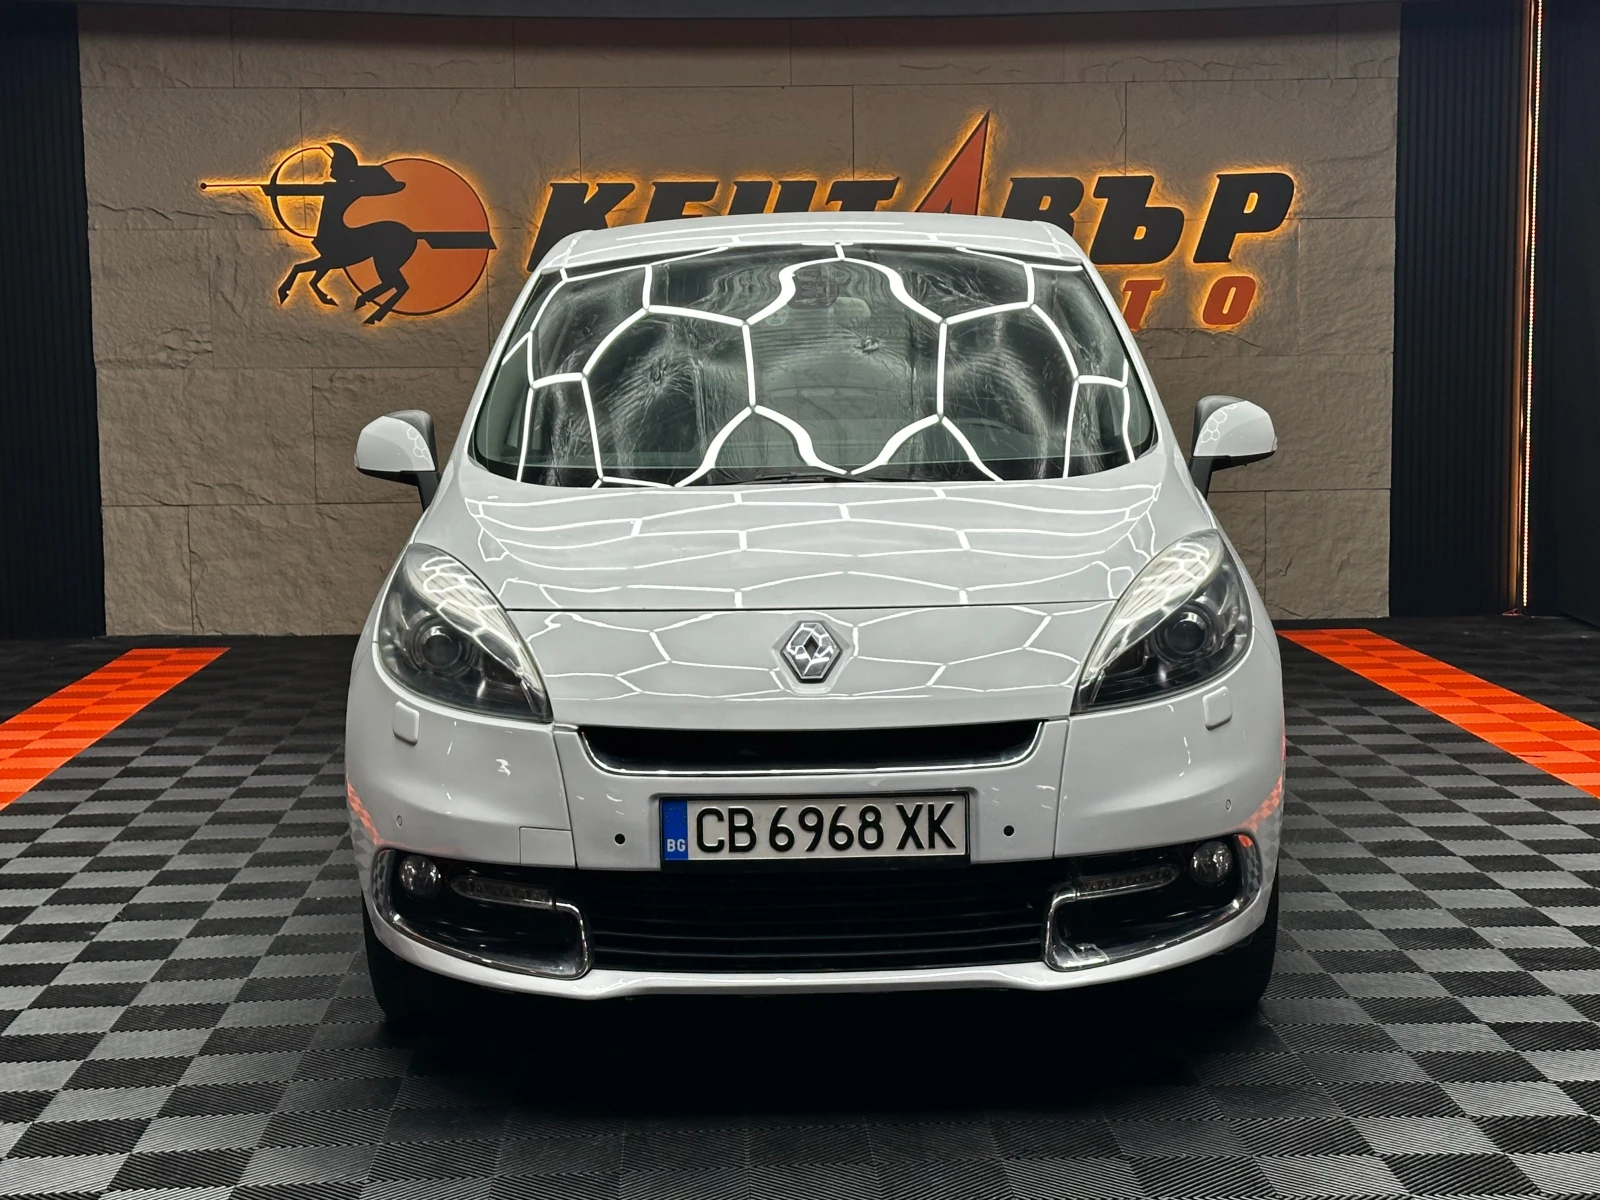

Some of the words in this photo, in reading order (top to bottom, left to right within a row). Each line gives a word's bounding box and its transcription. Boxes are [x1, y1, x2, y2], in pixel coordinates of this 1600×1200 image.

[696, 806, 757, 853] CB
[769, 804, 884, 853] 6968
[895, 802, 956, 850] XK
[666, 838, 686, 852] BG
